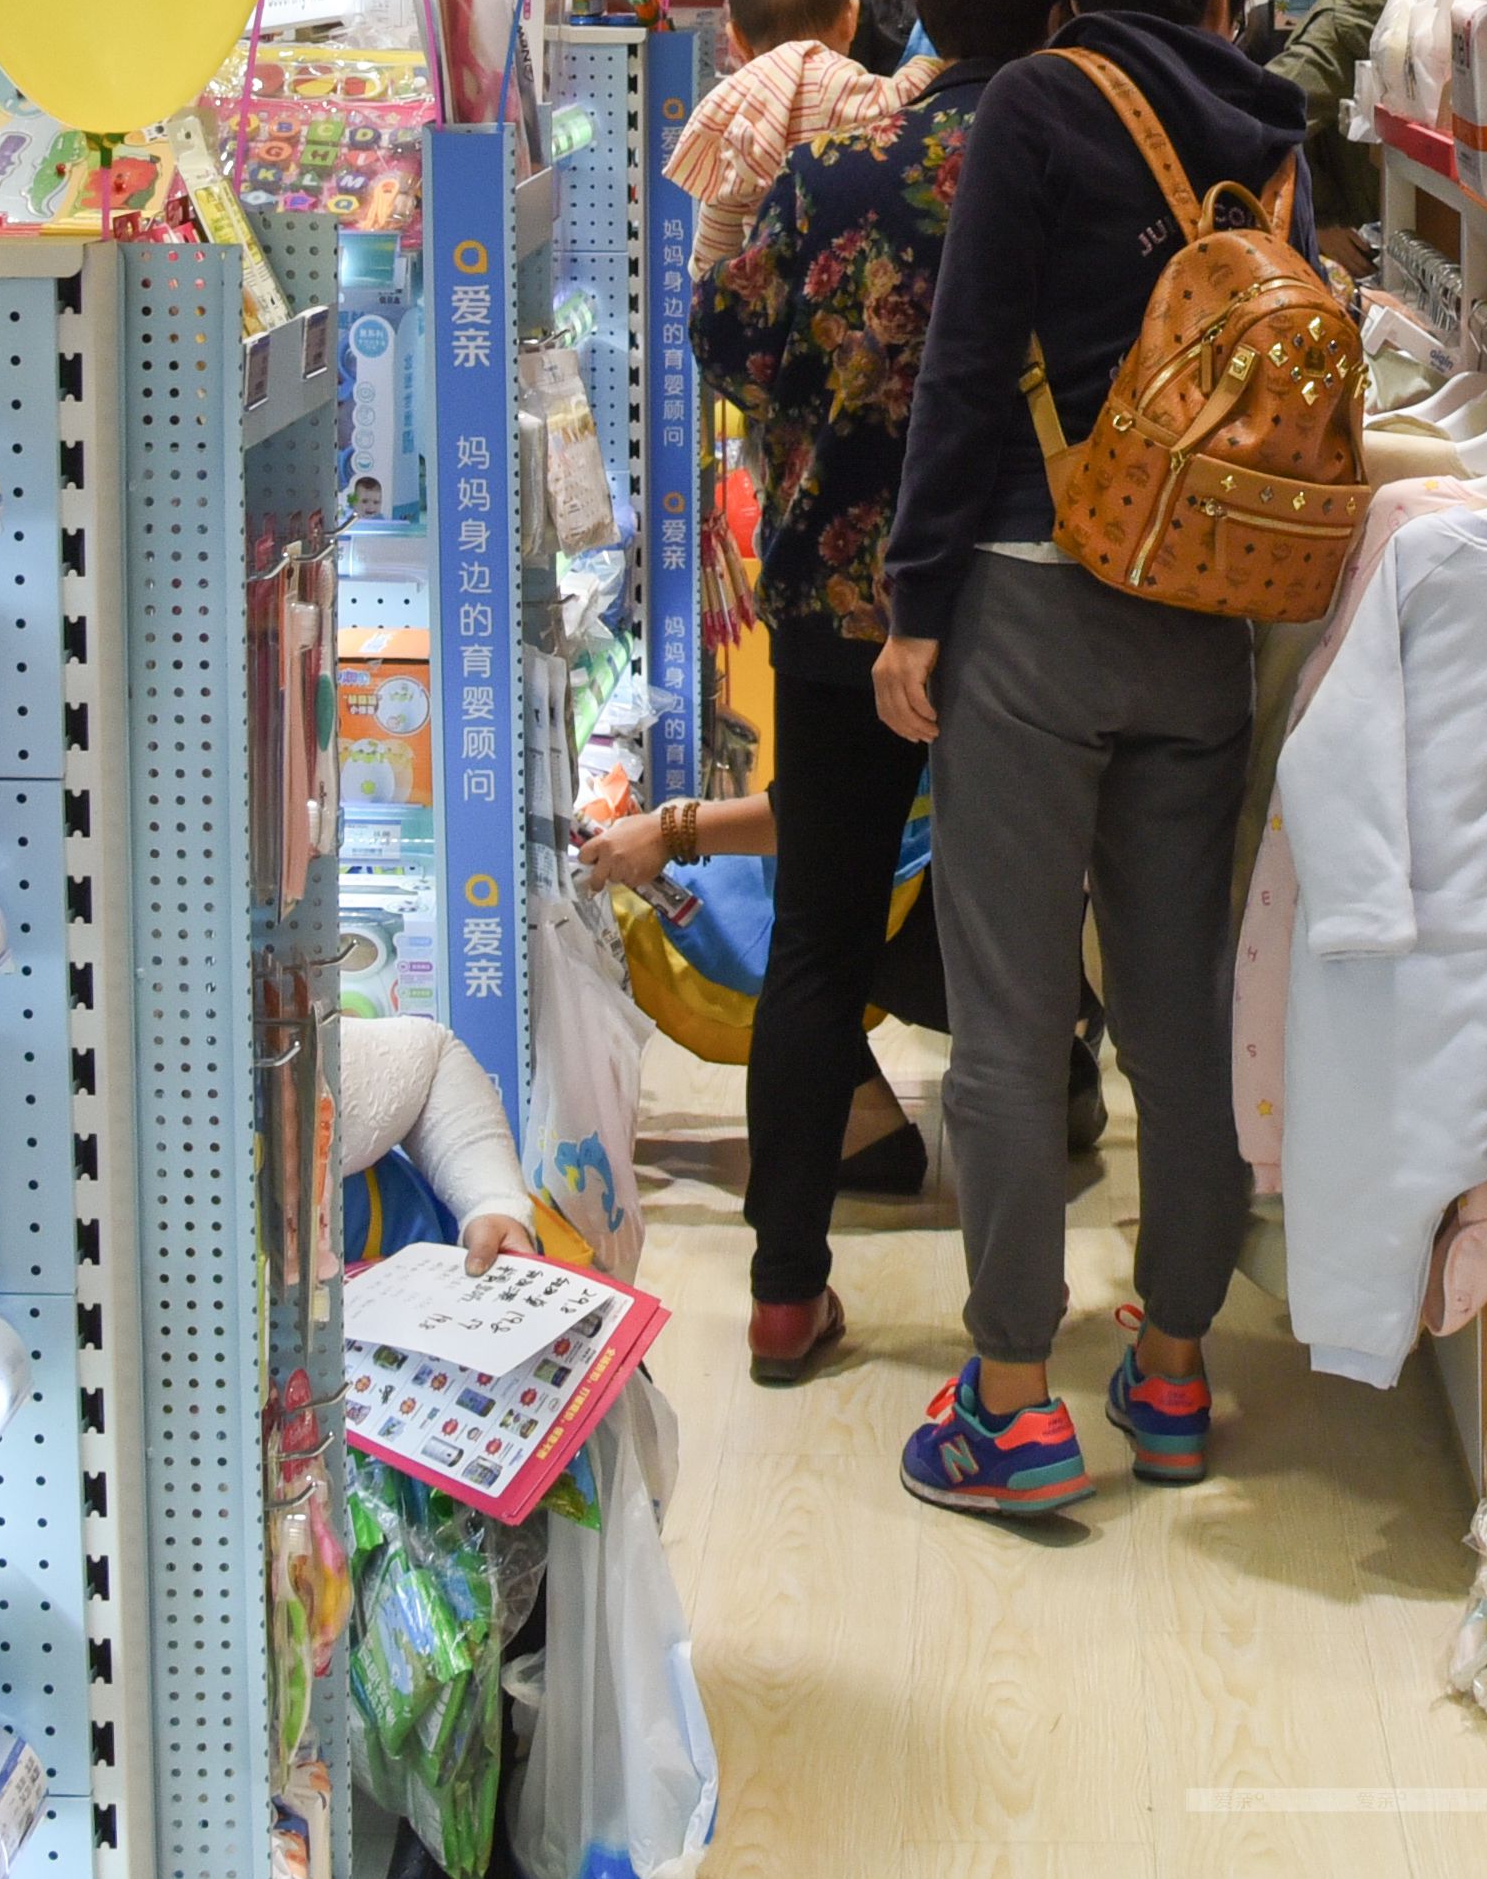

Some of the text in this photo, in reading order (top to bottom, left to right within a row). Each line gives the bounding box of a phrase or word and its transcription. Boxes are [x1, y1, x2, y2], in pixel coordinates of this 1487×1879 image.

[451, 284, 492, 368] 爱亲
[662, 219, 685, 448] 妈妈身边的育婴顾问
[661, 519, 687, 570] 爱亲
[456, 435, 496, 803] 妈妈身边的育婴顾问
[663, 615, 686, 802] 妈妈身边的育婴
[463, 916, 504, 999] 爱亲
